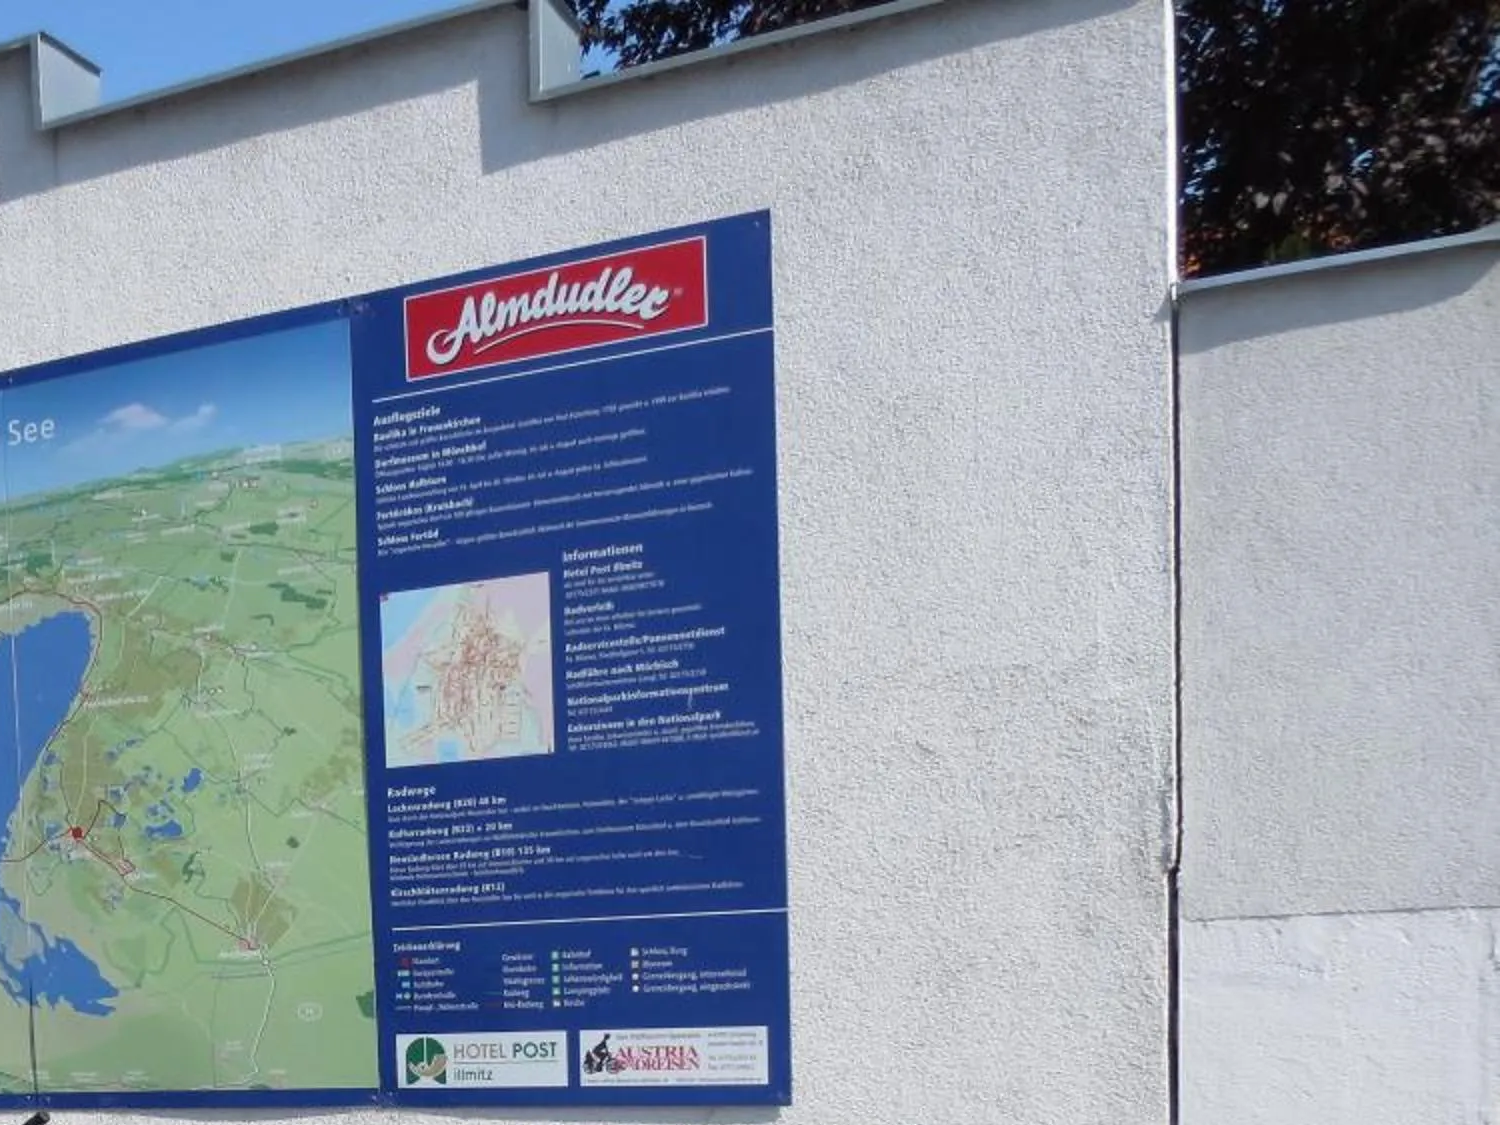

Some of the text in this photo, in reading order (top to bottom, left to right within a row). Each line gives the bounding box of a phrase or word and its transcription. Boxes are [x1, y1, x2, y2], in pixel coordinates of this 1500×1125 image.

[426, 266, 669, 365] Almdudler
[7, 417, 56, 447] See
[563, 543, 644, 563] Informationen
[453, 1041, 557, 1060] HOTEL POST
[615, 1045, 698, 1060] AUSTRIA
